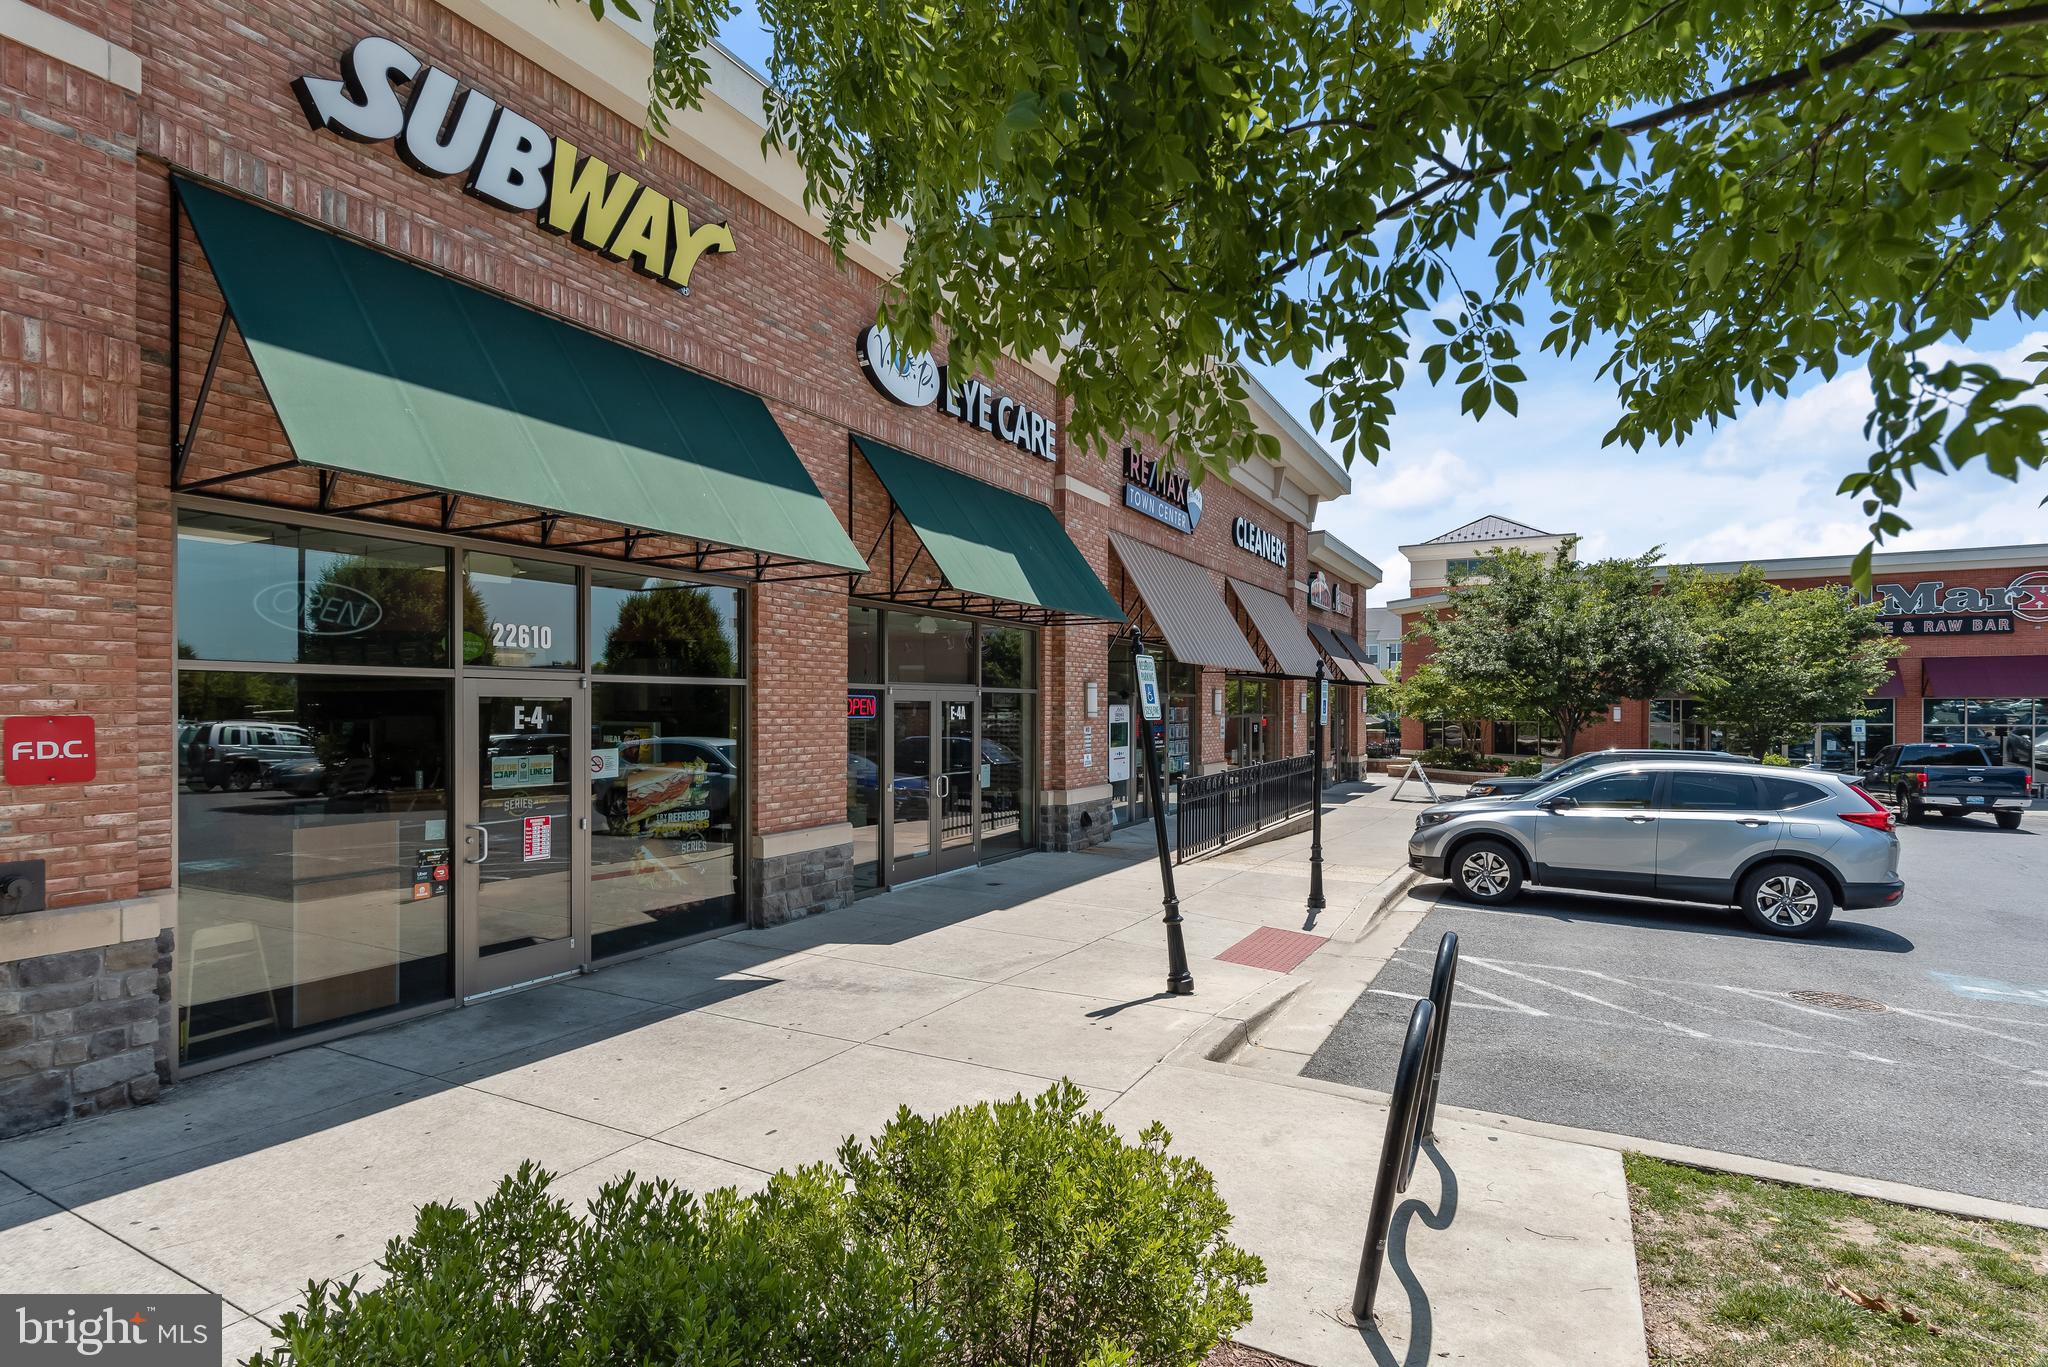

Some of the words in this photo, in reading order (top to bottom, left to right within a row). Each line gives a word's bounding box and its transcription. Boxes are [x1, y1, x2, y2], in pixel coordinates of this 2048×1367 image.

[299, 36, 737, 288] SUBWAY
[946, 366, 992, 432] EYE
[998, 396, 1057, 462] CARE
[1130, 450, 1185, 505] RE/MAX
[1130, 488, 1156, 514] TOWN
[1158, 503, 1187, 528] CENTER
[1235, 516, 1288, 569] CLEANERS
[271, 587, 368, 628] OPEN
[492, 622, 552, 650] 22610
[1902, 621, 1915, 634] &
[1923, 619, 1963, 633] RAW
[1972, 618, 2010, 632] BAR
[514, 705, 544, 730] E-4
[847, 698, 875, 716] OPEN
[950, 705, 966, 721] E-4A
[12, 740, 89, 761] F.D.C.
[504, 770, 518, 779] APP
[530, 767, 544, 776] LINE
[504, 798, 534, 812] SERIES
[668, 809, 710, 824] REFRESHED
[681, 841, 707, 854] SERIES
